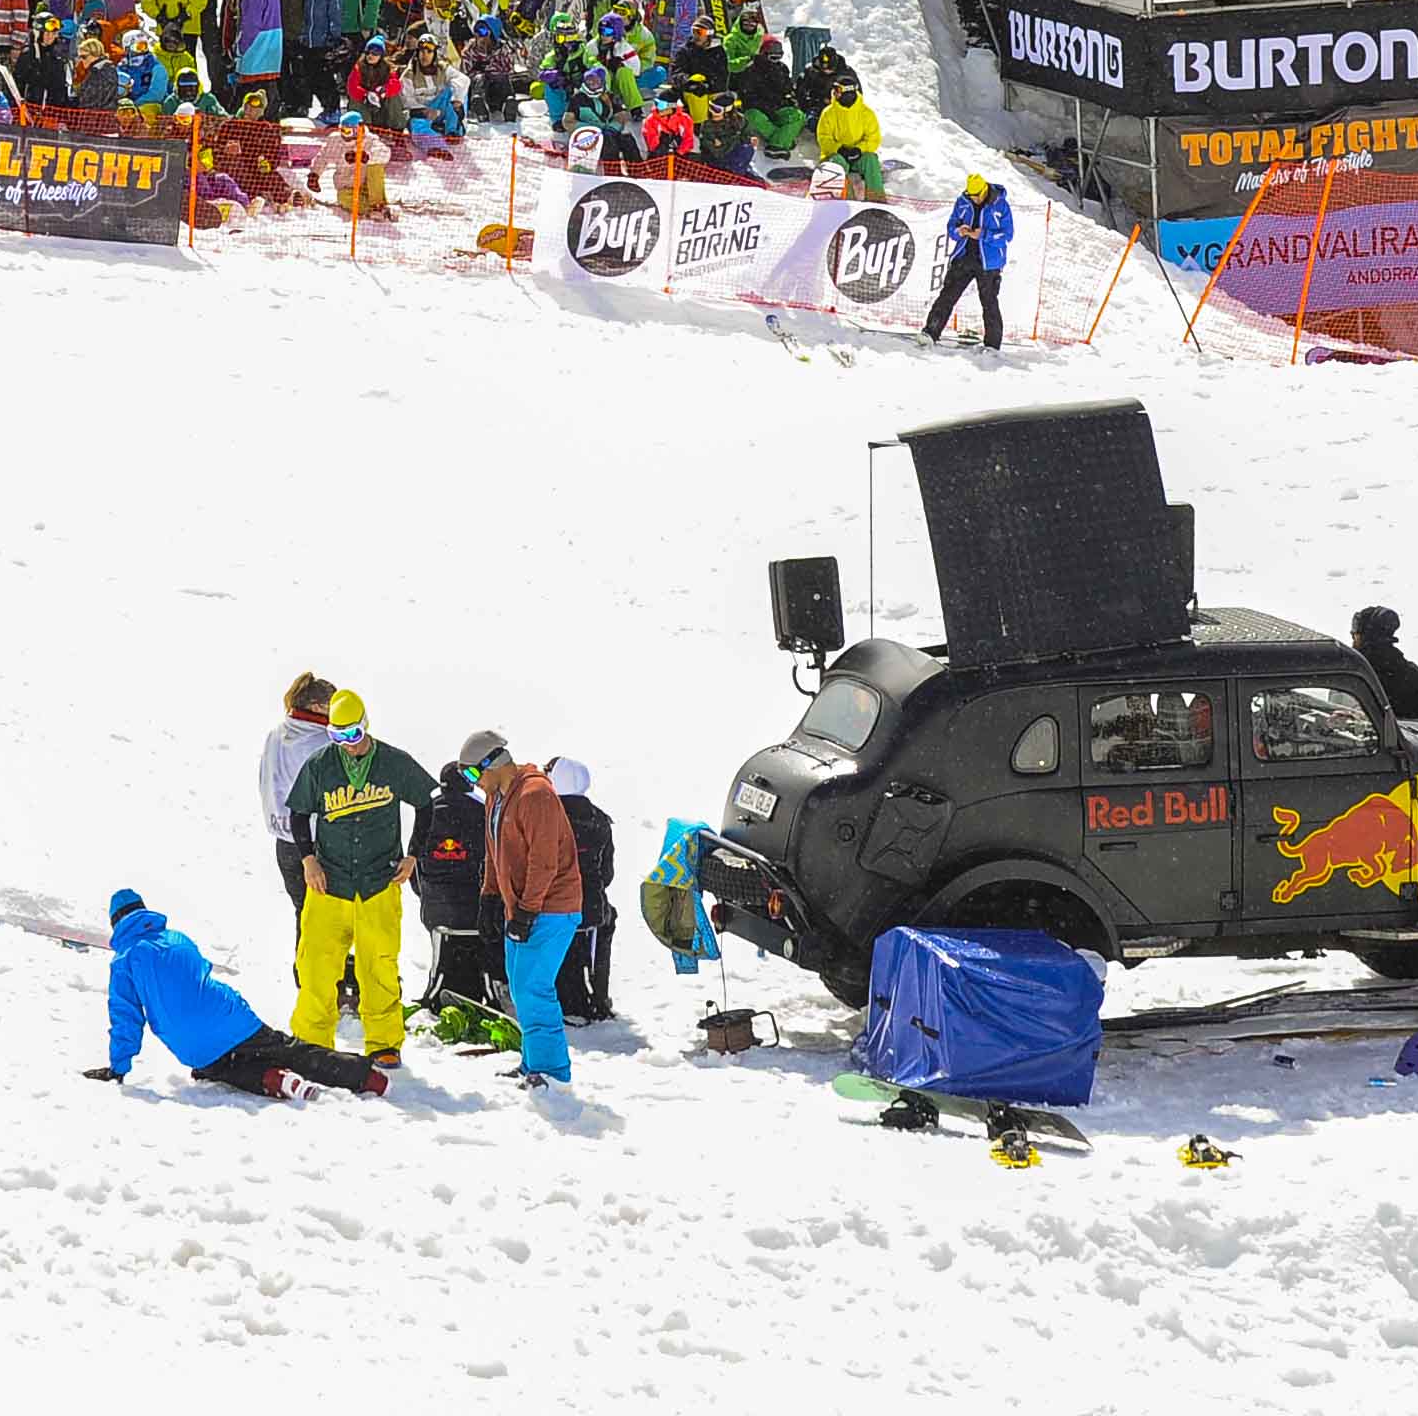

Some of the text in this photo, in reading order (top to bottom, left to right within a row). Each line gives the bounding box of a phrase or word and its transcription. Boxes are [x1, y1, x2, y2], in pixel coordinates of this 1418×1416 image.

[1008, 8, 1106, 83] BURTON
[23, 142, 162, 190] FIGHT
[1181, 128, 1304, 167] TOTAL
[1292, 159, 1310, 184] of
[1310, 149, 1374, 178] Frestyle
[4, 181, 25, 205] of
[25, 177, 99, 205] Freestyle
[680, 201, 753, 237] FLAT IS
[323, 782, 394, 814] Athletics
[1086, 785, 1229, 831] Red Bull
